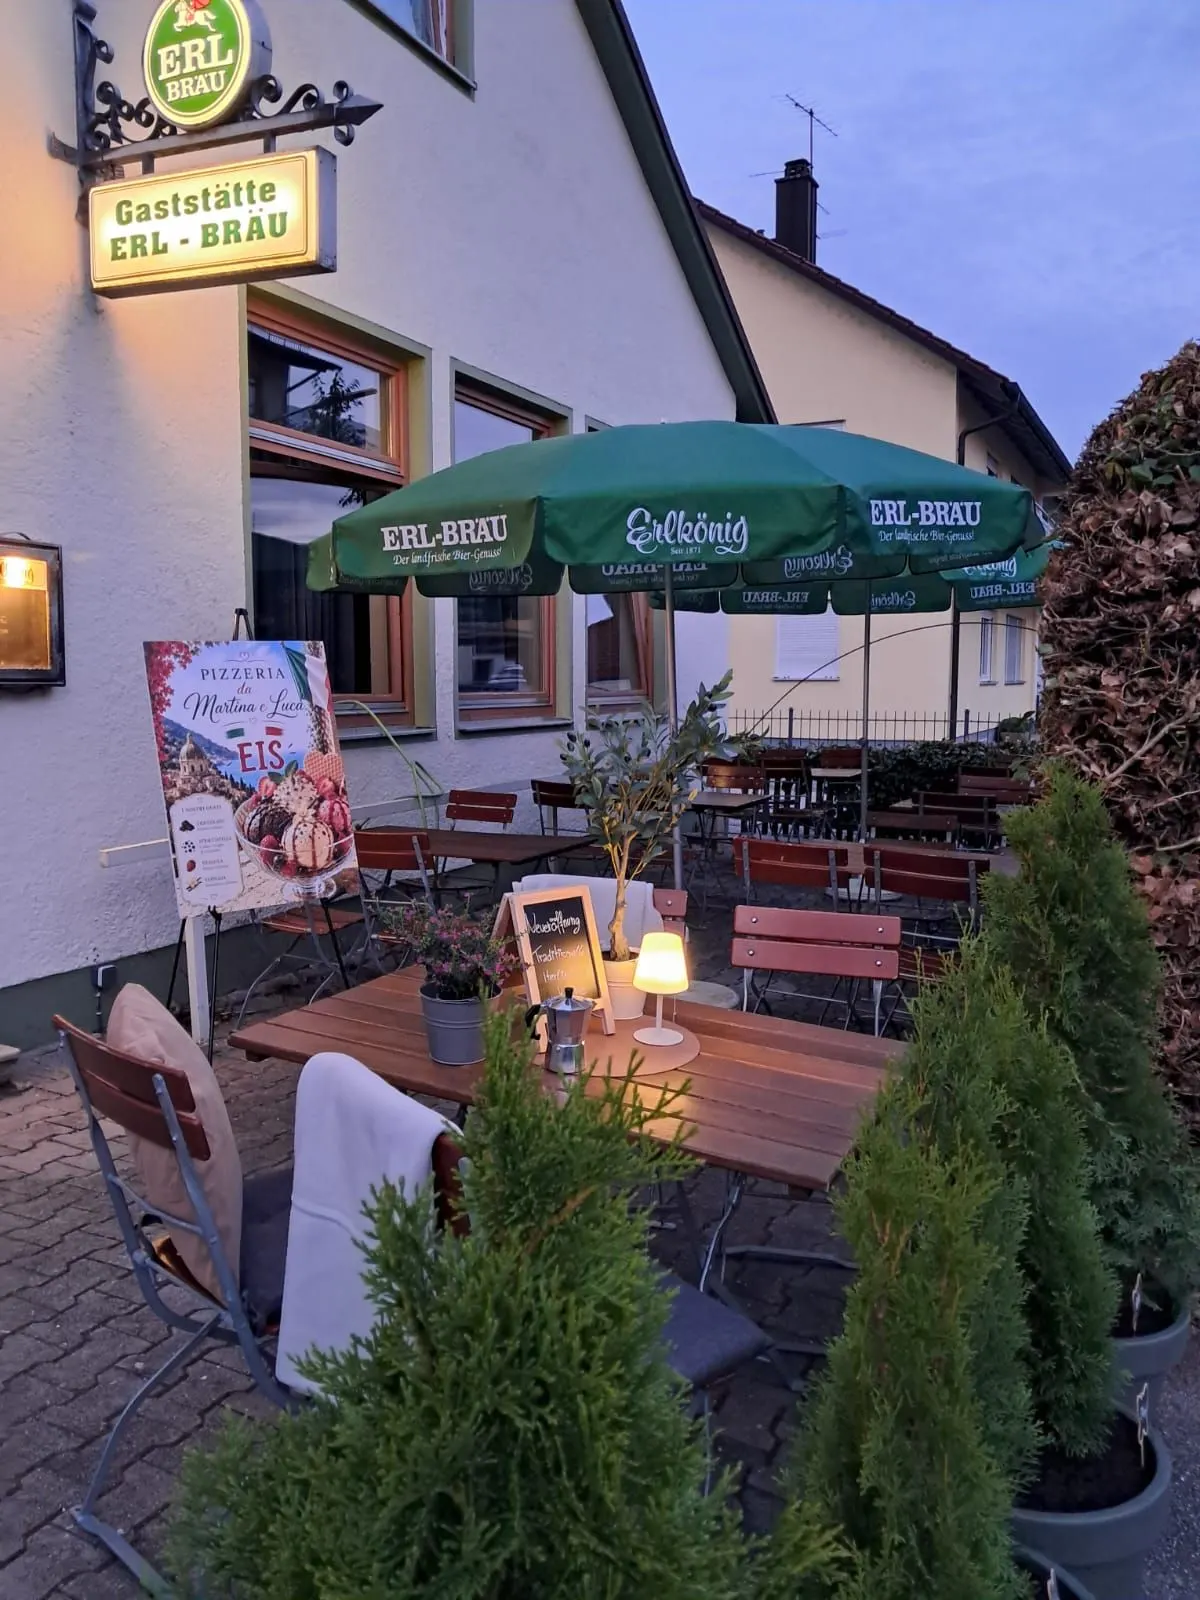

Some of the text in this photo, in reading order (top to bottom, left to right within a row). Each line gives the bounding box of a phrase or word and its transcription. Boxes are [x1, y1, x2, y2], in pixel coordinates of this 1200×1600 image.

[157, 33, 234, 81] ERL
[166, 69, 227, 102] BRÄU
[115, 180, 277, 226] Gaststätte
[110, 231, 169, 262] ERL
[200, 207, 289, 249] BRÄU
[869, 499, 982, 526] ERL-BRÄU
[380, 514, 508, 552] ERL-BRÄU
[625, 507, 749, 555] Erlkönig
[392, 554, 410, 566] Der
[200, 667, 286, 681] PIZZERIA
[236, 681, 253, 695] da
[183, 692, 257, 724] Martina
[266, 688, 305, 719] Luca
[236, 740, 285, 772] EIS
